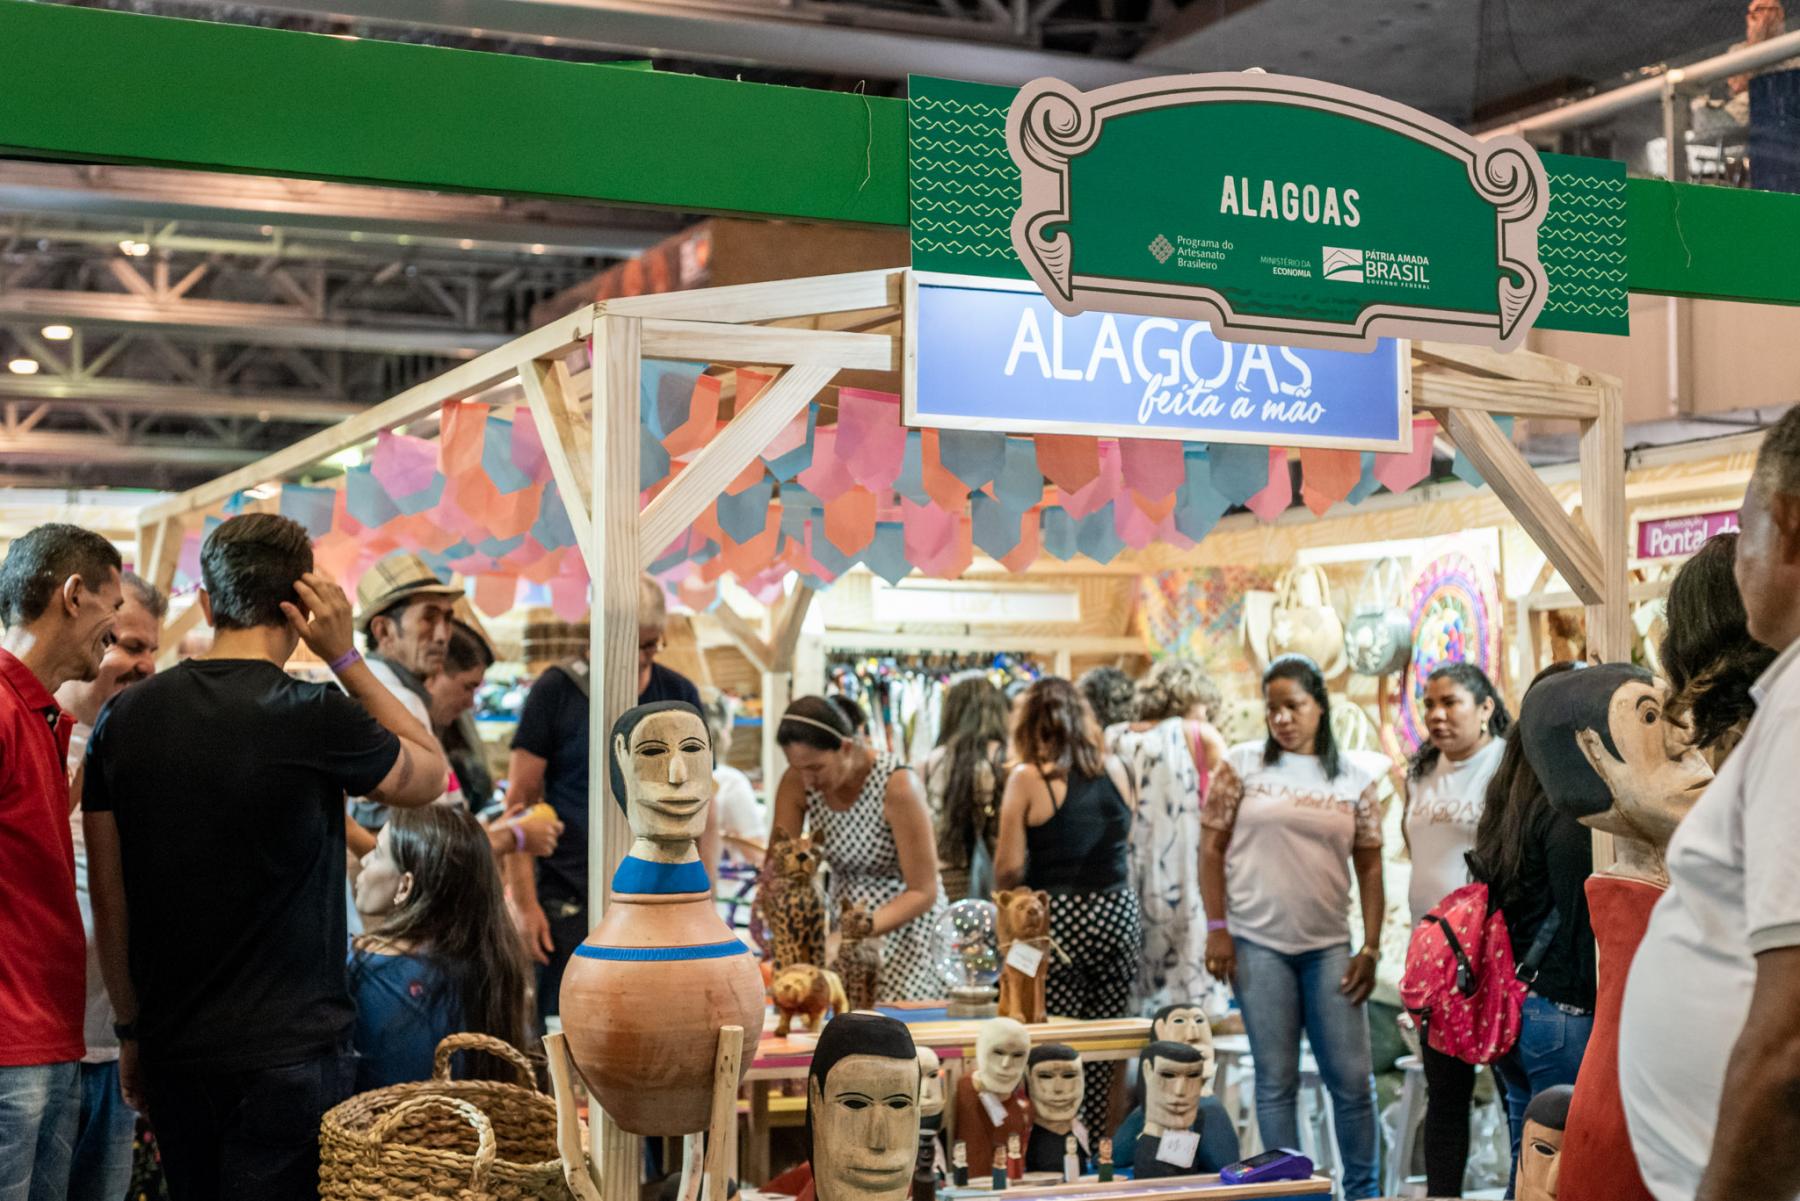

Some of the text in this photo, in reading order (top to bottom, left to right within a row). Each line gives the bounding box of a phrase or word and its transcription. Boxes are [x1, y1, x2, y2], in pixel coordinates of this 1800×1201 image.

[1220, 175, 1361, 227] ALAGOAS
[1177, 235, 1234, 250] Programa do
[1177, 247, 1226, 260] Artesanato
[1365, 249, 1430, 266] PÁTRIA AMADA
[1177, 258, 1218, 271] Brasileiro
[1260, 255, 1312, 268] MINISTÉRIO DA
[1273, 267, 1312, 278] ECONOMIA
[1366, 260, 1430, 283] BRASIL
[1366, 279, 1430, 290] GOVERNO FEDERAL
[1137, 373, 1326, 425] feita à mão
[1649, 519, 1709, 556] Pontal
